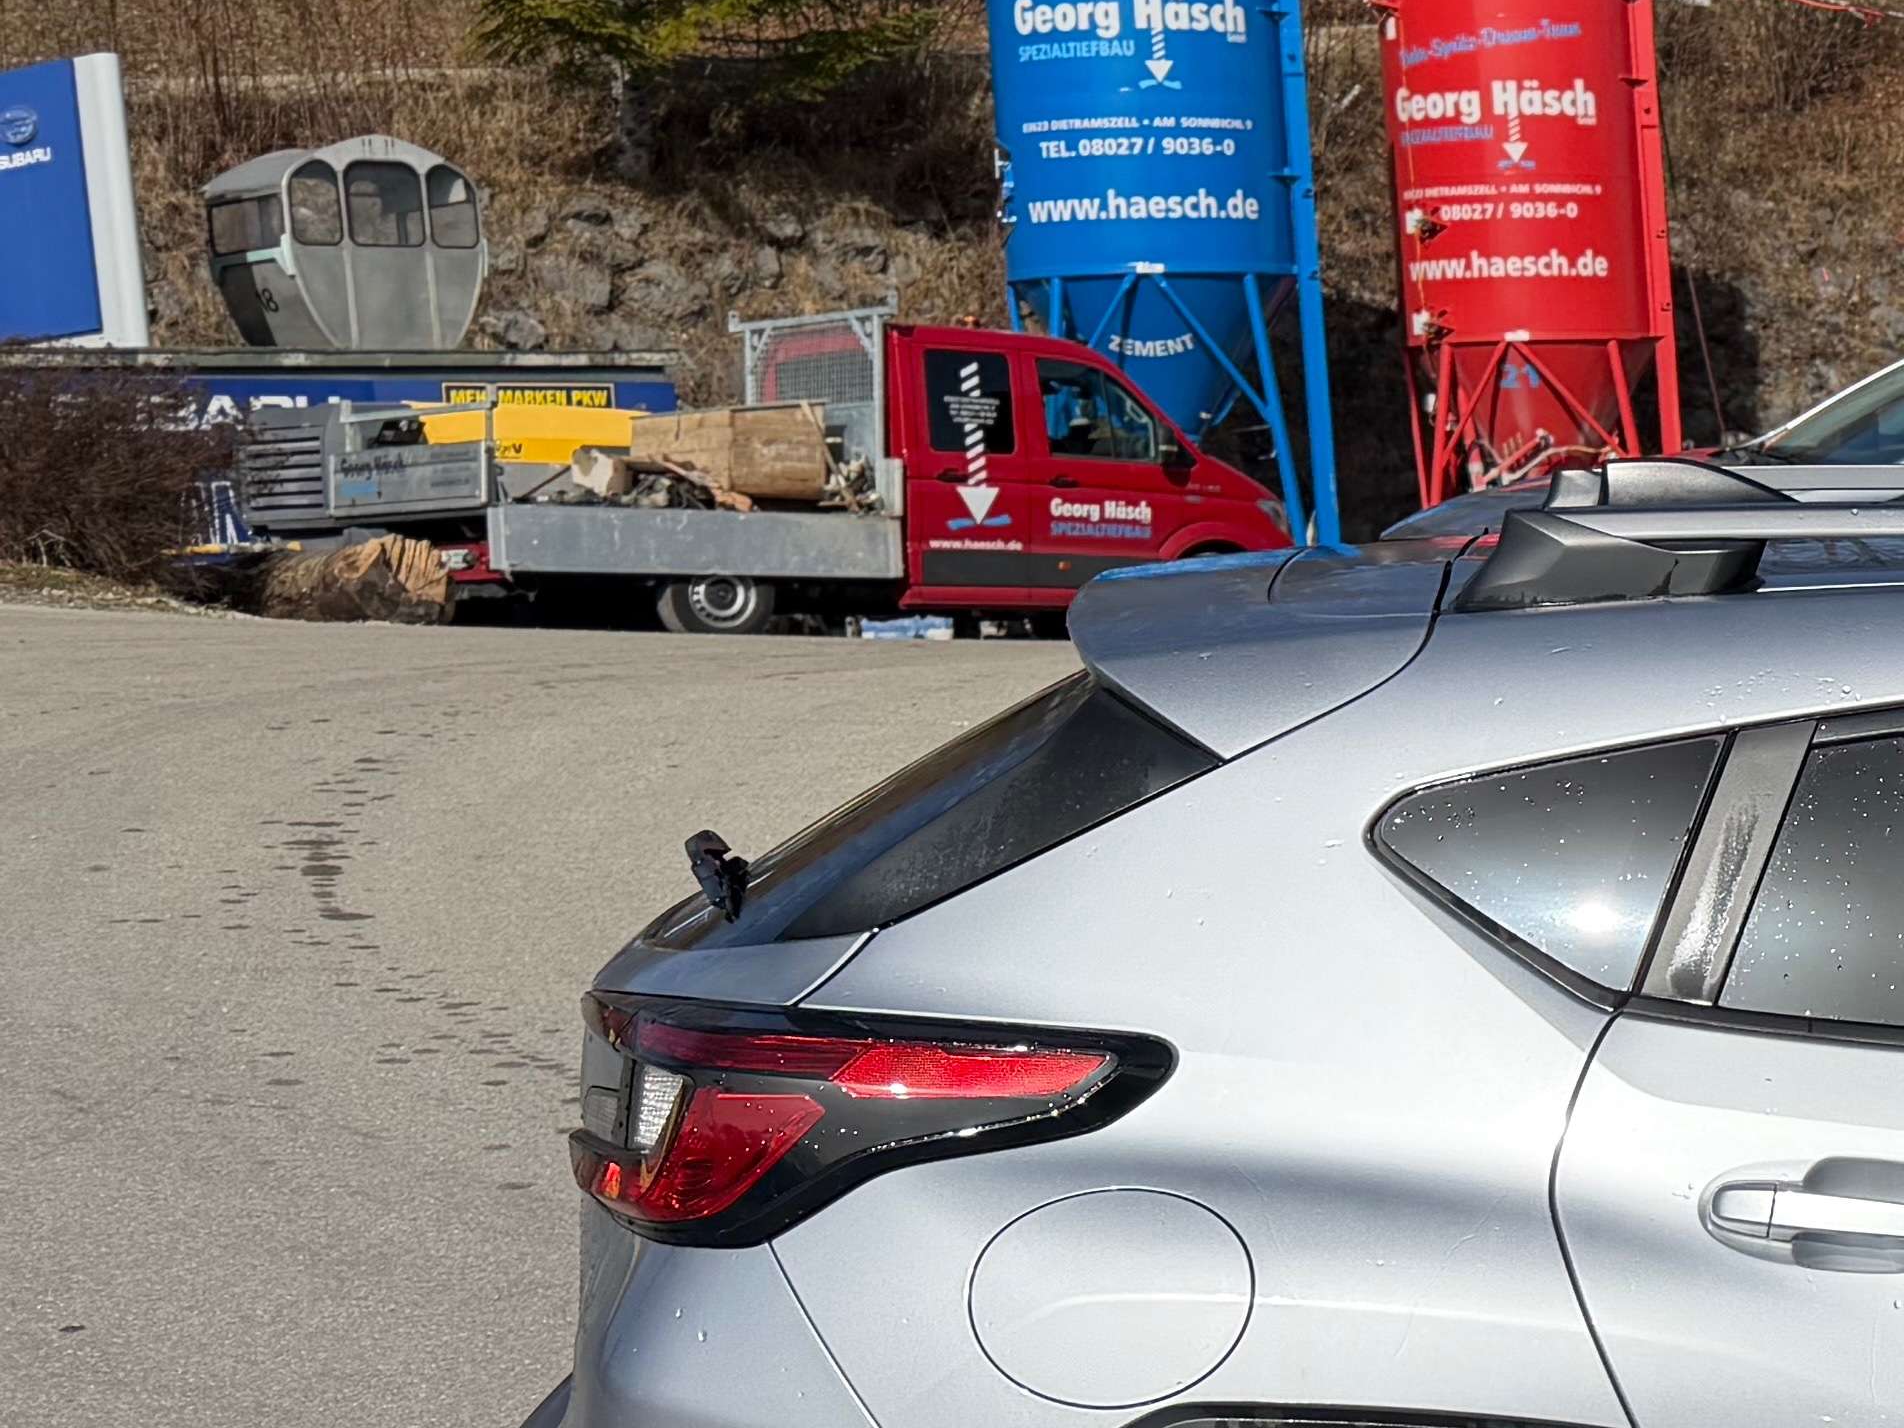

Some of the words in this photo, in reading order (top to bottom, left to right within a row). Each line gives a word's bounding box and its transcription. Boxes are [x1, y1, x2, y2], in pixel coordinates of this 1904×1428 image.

[1018, 39, 1136, 62] SPEZIALTIEFBAU
[1396, 87, 1481, 124] Georg
[1491, 78, 1596, 117] Häsch
[1161, 137, 1235, 156] 9036-0
[1028, 188, 1260, 223] www.haesch.de
[1510, 201, 1578, 219] 9036-0
[1409, 248, 1609, 281] www.haesch.de
[1108, 333, 1195, 357] ZEMENT
[1050, 498, 1100, 521] Georg
